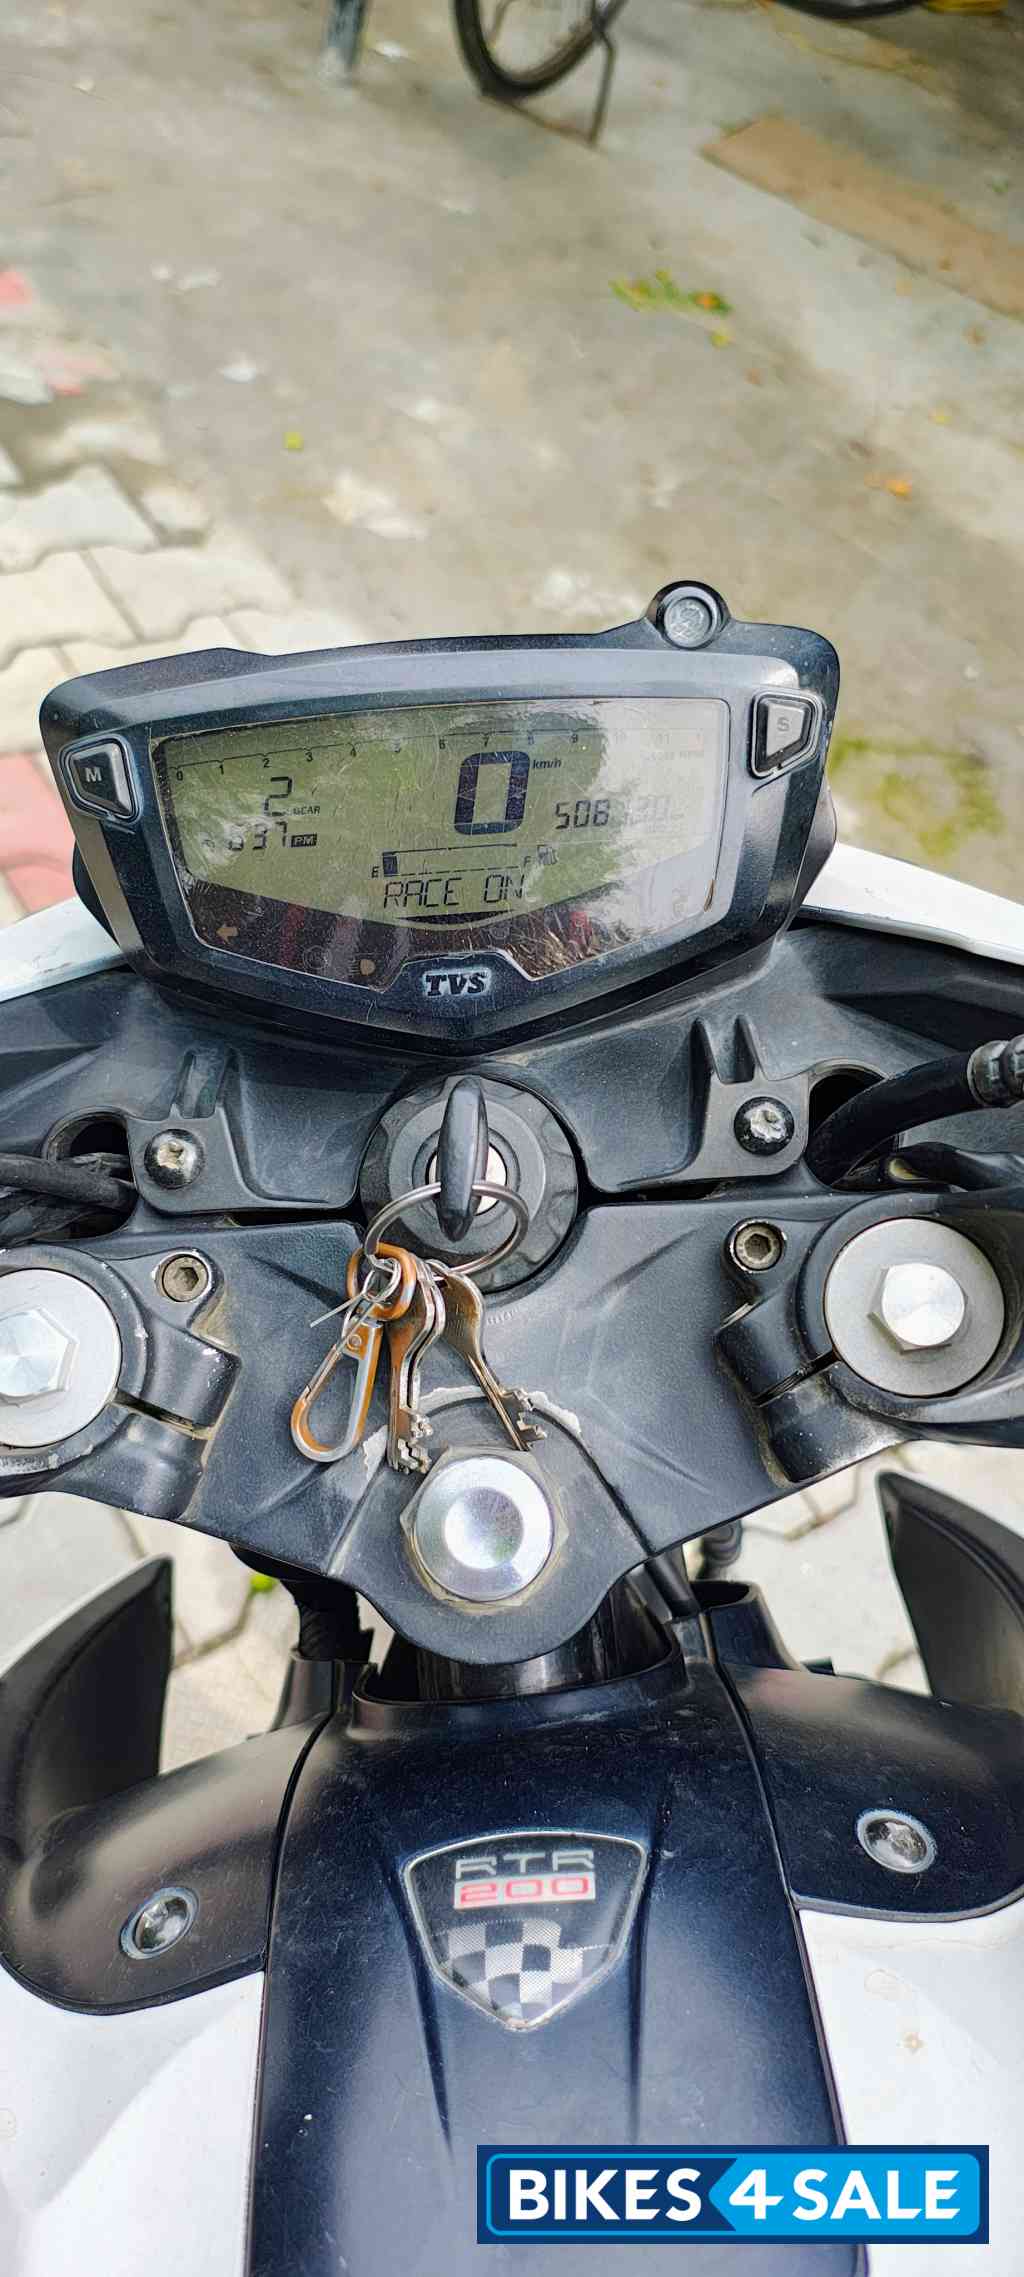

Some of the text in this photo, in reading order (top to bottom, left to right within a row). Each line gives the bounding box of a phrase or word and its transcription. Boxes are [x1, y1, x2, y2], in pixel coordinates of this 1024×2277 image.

[777, 717, 790, 732] S
[176, 770, 183, 781] 0
[263, 758, 270, 769] 2
[305, 751, 313, 762] 3
[438, 738, 446, 750] 6
[481, 736, 490, 748] 7
[532, 759, 562, 769] km/h
[85, 767, 102, 782] M
[264, 776, 292, 817] 2
[454, 751, 530, 835] 0
[291, 833, 317, 848] PM
[371, 866, 379, 878] E
[383, 874, 525, 908] RACE ON
[424, 970, 486, 997] TVS
[455, 1850, 594, 1879] RTR
[459, 1876, 589, 1904] 200
